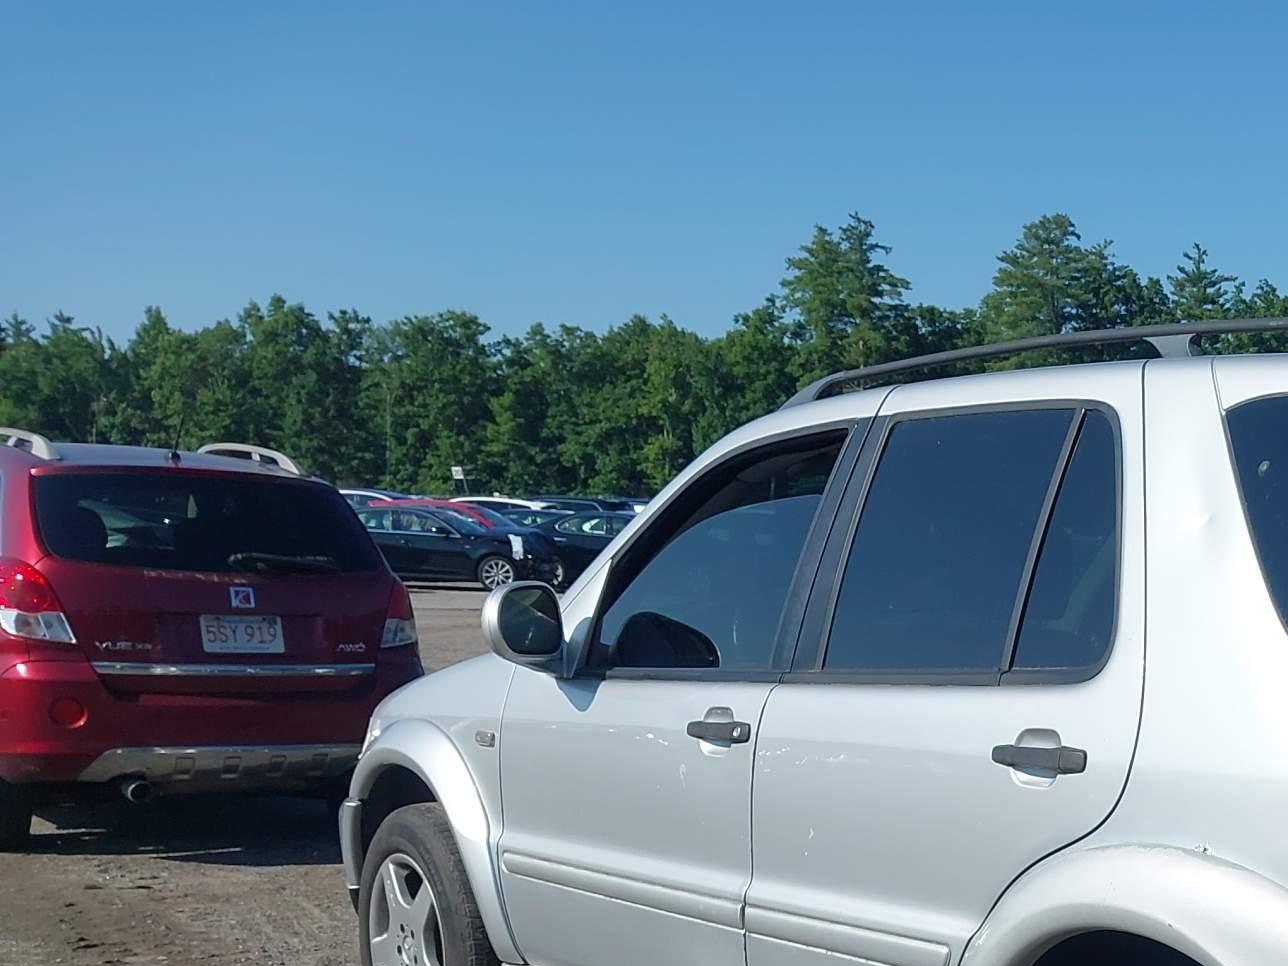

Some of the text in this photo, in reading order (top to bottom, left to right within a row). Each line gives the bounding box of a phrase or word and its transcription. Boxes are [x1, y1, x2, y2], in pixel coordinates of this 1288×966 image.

[206, 624, 277, 643] 5SY 919
[94, 640, 132, 651] VUE
[336, 641, 366, 652] AWD
